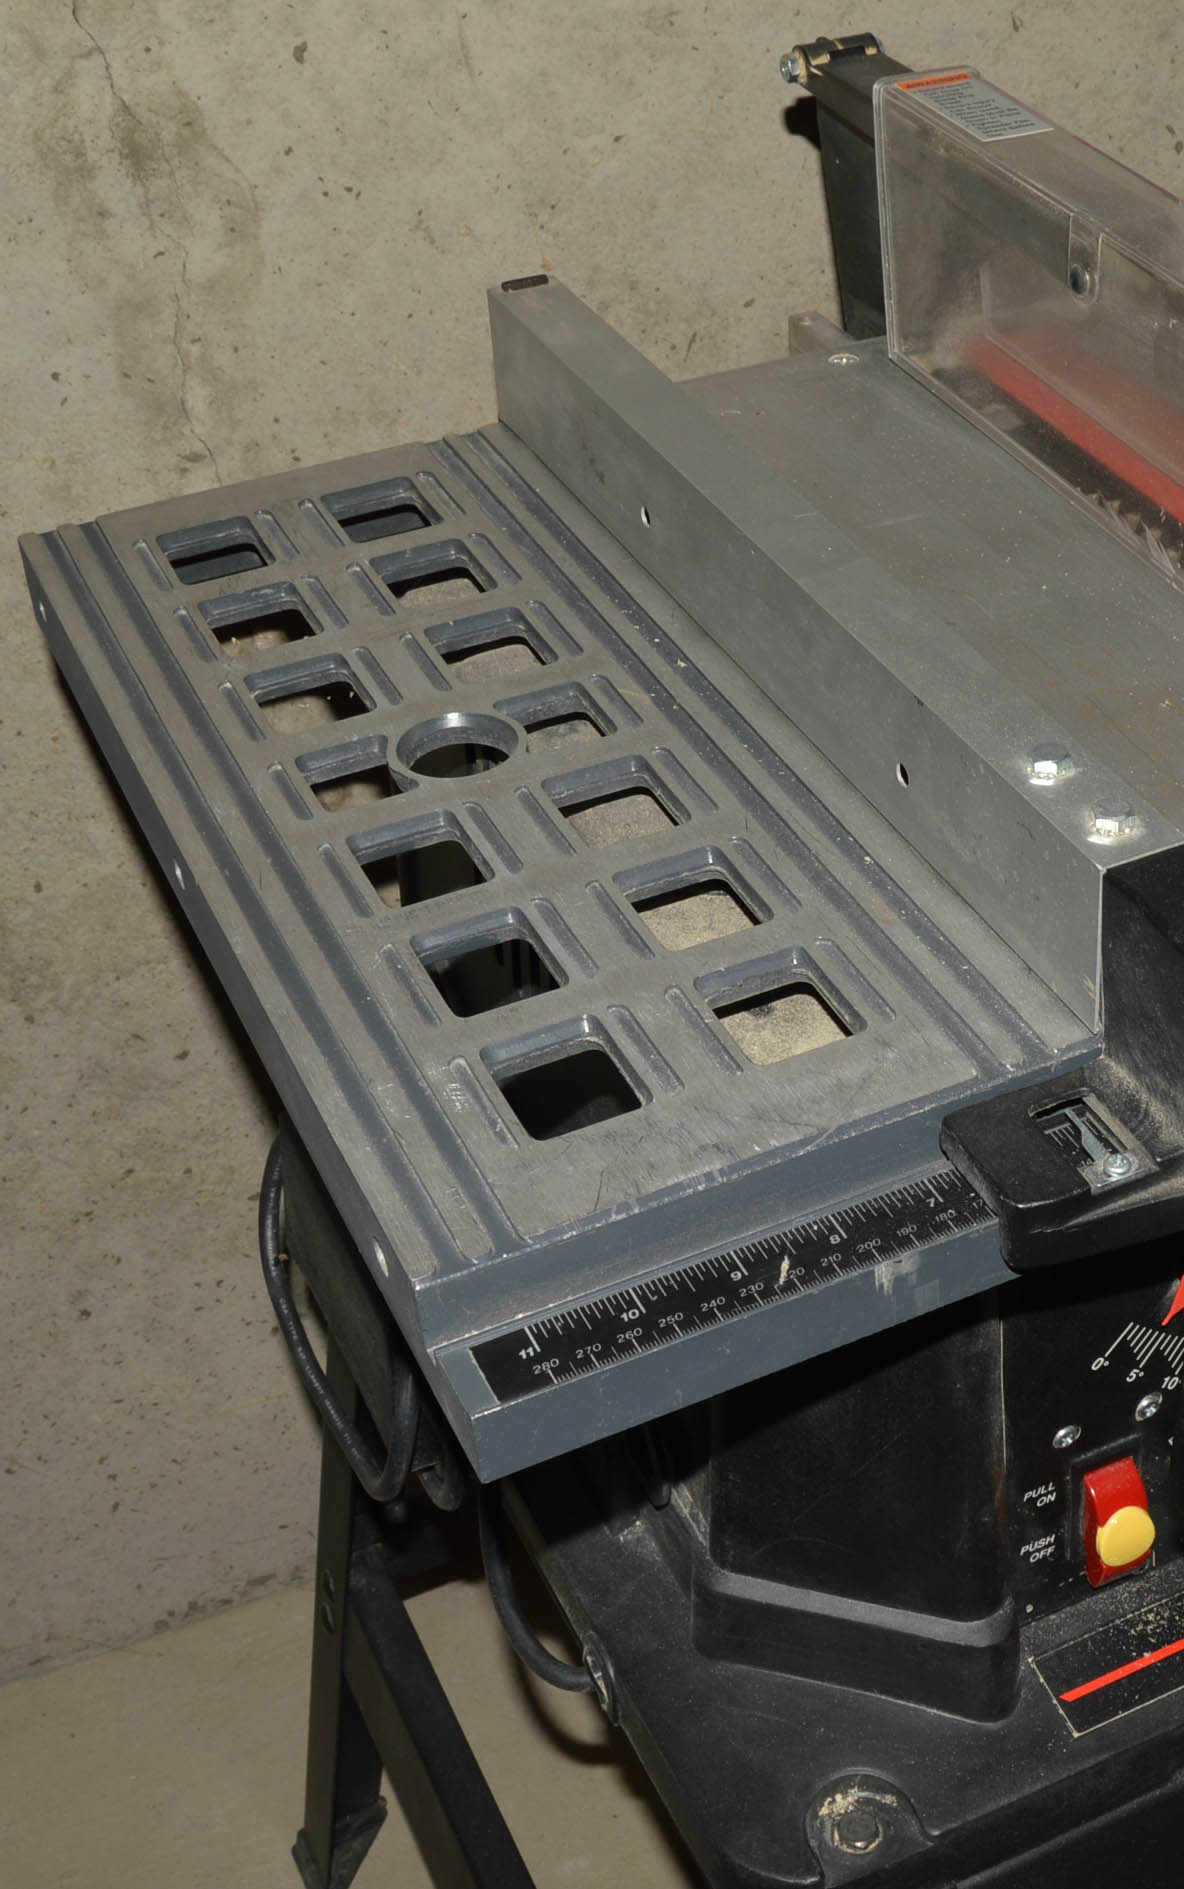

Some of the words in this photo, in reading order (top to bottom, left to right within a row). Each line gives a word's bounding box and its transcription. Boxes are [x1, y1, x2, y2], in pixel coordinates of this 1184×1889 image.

[518, 1346, 535, 1360] 11
[620, 1307, 640, 1323] 10
[730, 1270, 743, 1282] 9
[828, 1233, 842, 1245] 8
[926, 1197, 937, 1208] 7
[532, 1357, 560, 1375] 280
[575, 1343, 602, 1359] 270
[616, 1327, 643, 1344] 260
[657, 1311, 684, 1328] 250
[700, 1296, 726, 1313] 240
[738, 1281, 765, 1298] 230
[819, 1252, 842, 1268] 210
[855, 1238, 882, 1253] 200
[896, 1223, 918, 1238] 190
[933, 1208, 957, 1223] 180
[1023, 1481, 1056, 1502] PULL
[1036, 1492, 1057, 1508] ON
[1020, 1533, 1056, 1557] PUSH
[1029, 1545, 1056, 1563] OFF
